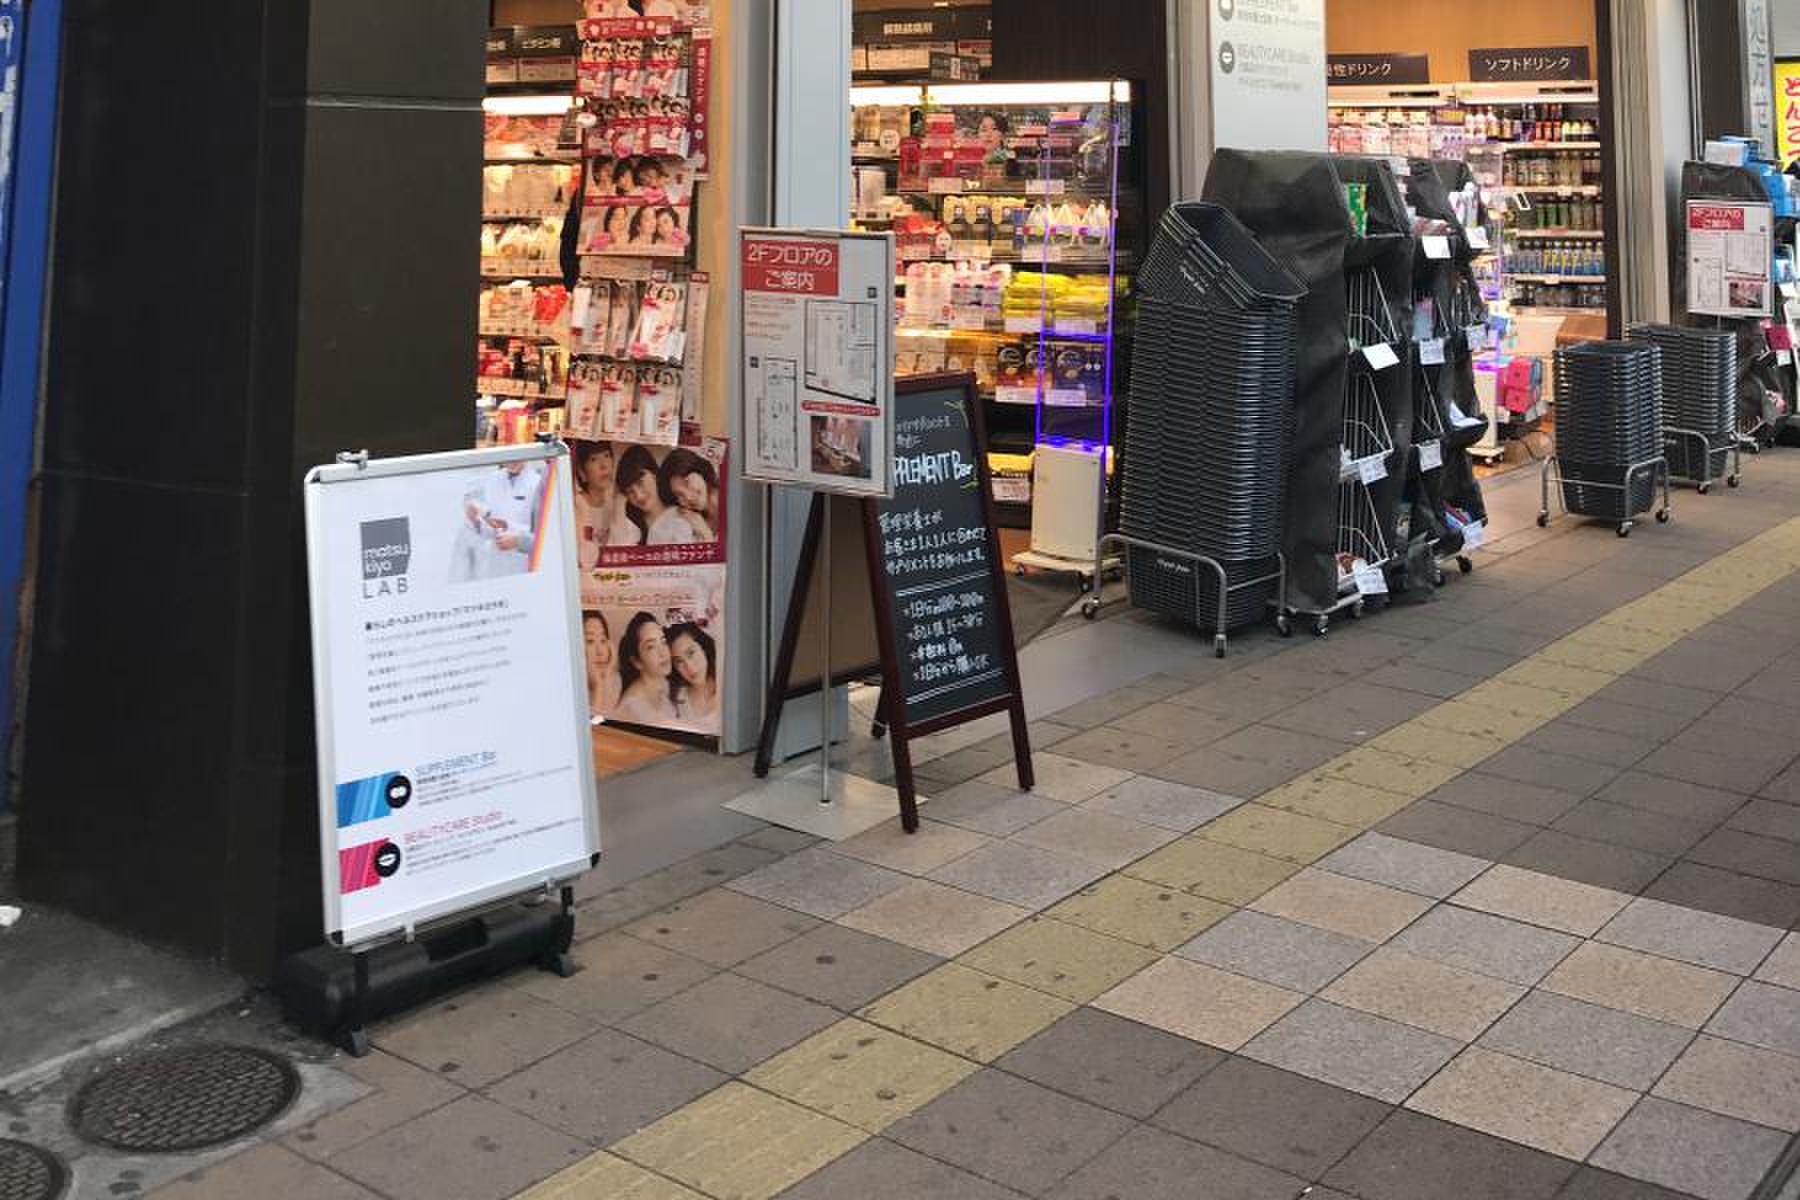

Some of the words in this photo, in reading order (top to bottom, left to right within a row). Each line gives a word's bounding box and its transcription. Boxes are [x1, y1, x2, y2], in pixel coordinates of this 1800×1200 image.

[1485, 56, 1571, 72] ソフトドリンク
[748, 243, 833, 267] 2Fフロアの
[765, 269, 815, 290] ご案内
[363, 577, 409, 599] LAB
